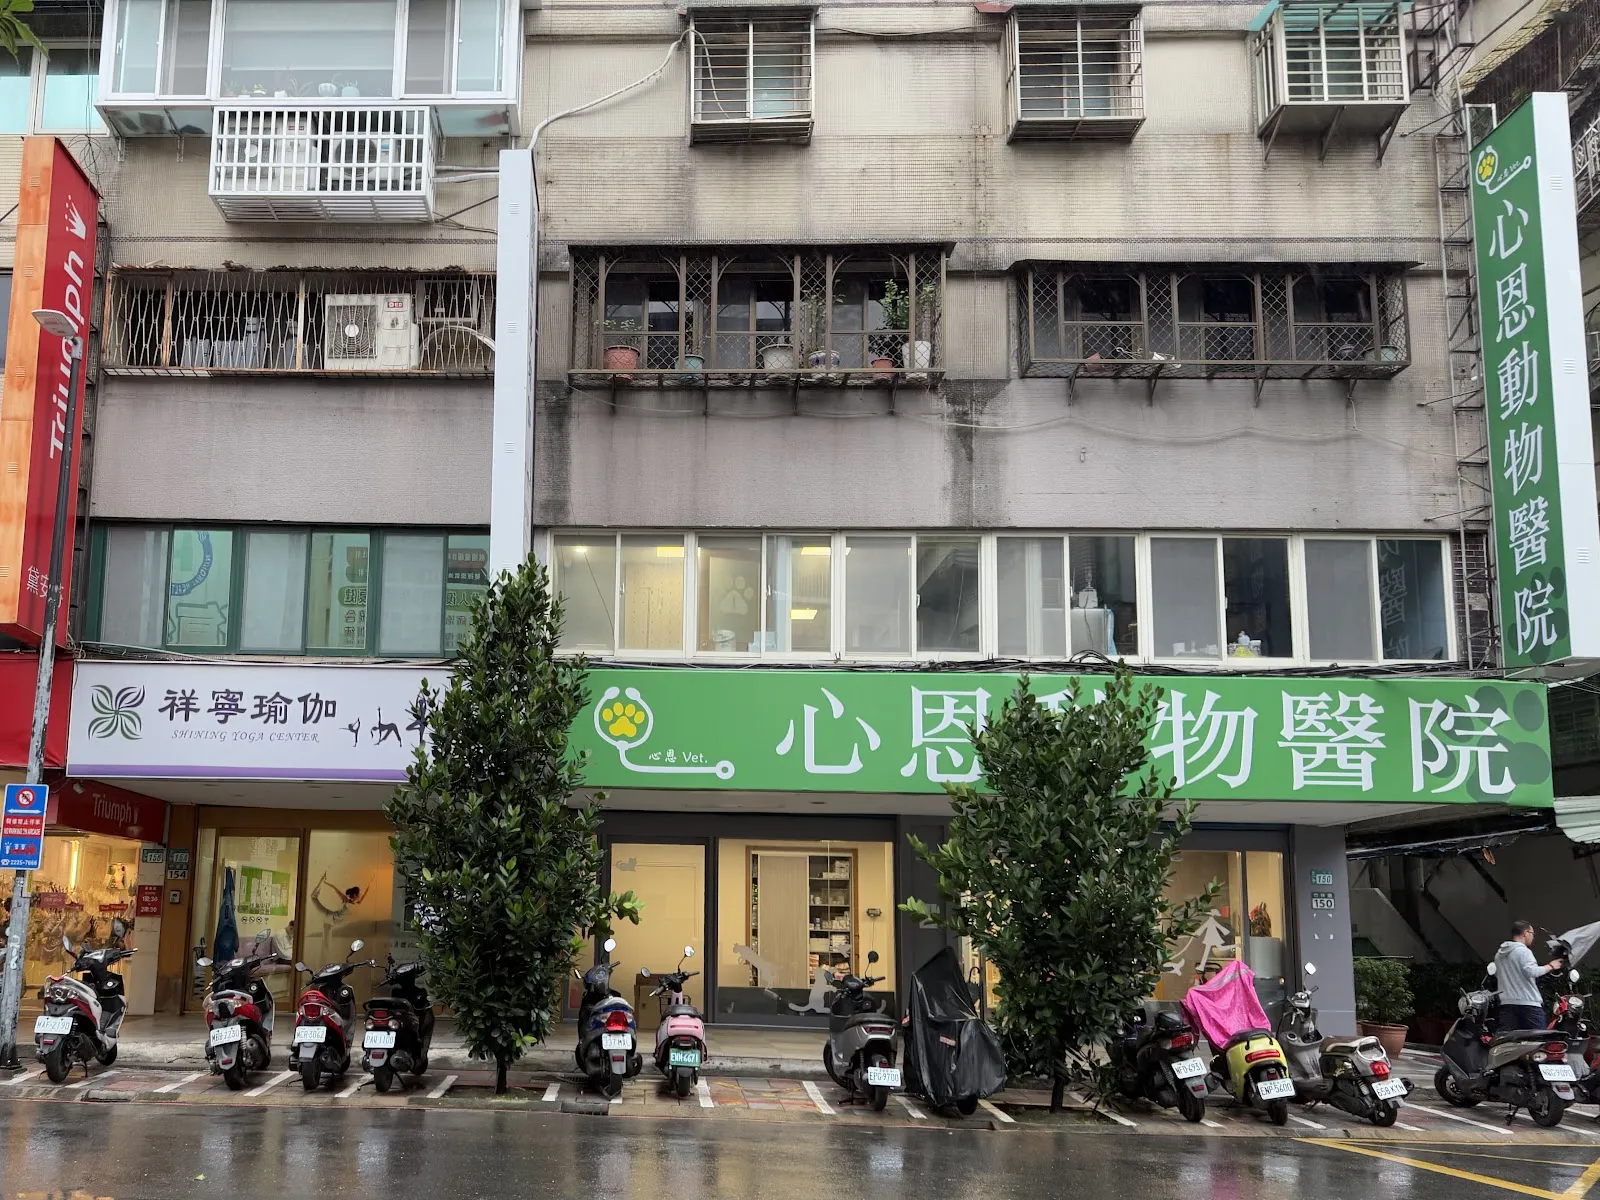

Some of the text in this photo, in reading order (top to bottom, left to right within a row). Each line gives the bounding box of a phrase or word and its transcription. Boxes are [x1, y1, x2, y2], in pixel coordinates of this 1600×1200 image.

[1489, 200, 1558, 656] 心恩動物醫院
[158, 688, 337, 725] 祥寧瑜伽
[171, 729, 321, 743] SHINING YOGA CENTER
[776, 685, 1517, 796] 心恩物醫院
[682, 751, 708, 764] Vet.
[92, 792, 132, 828] Triumph
[169, 870, 186, 879] 154
[1318, 875, 1331, 884] 150
[1314, 899, 1333, 908] 150
